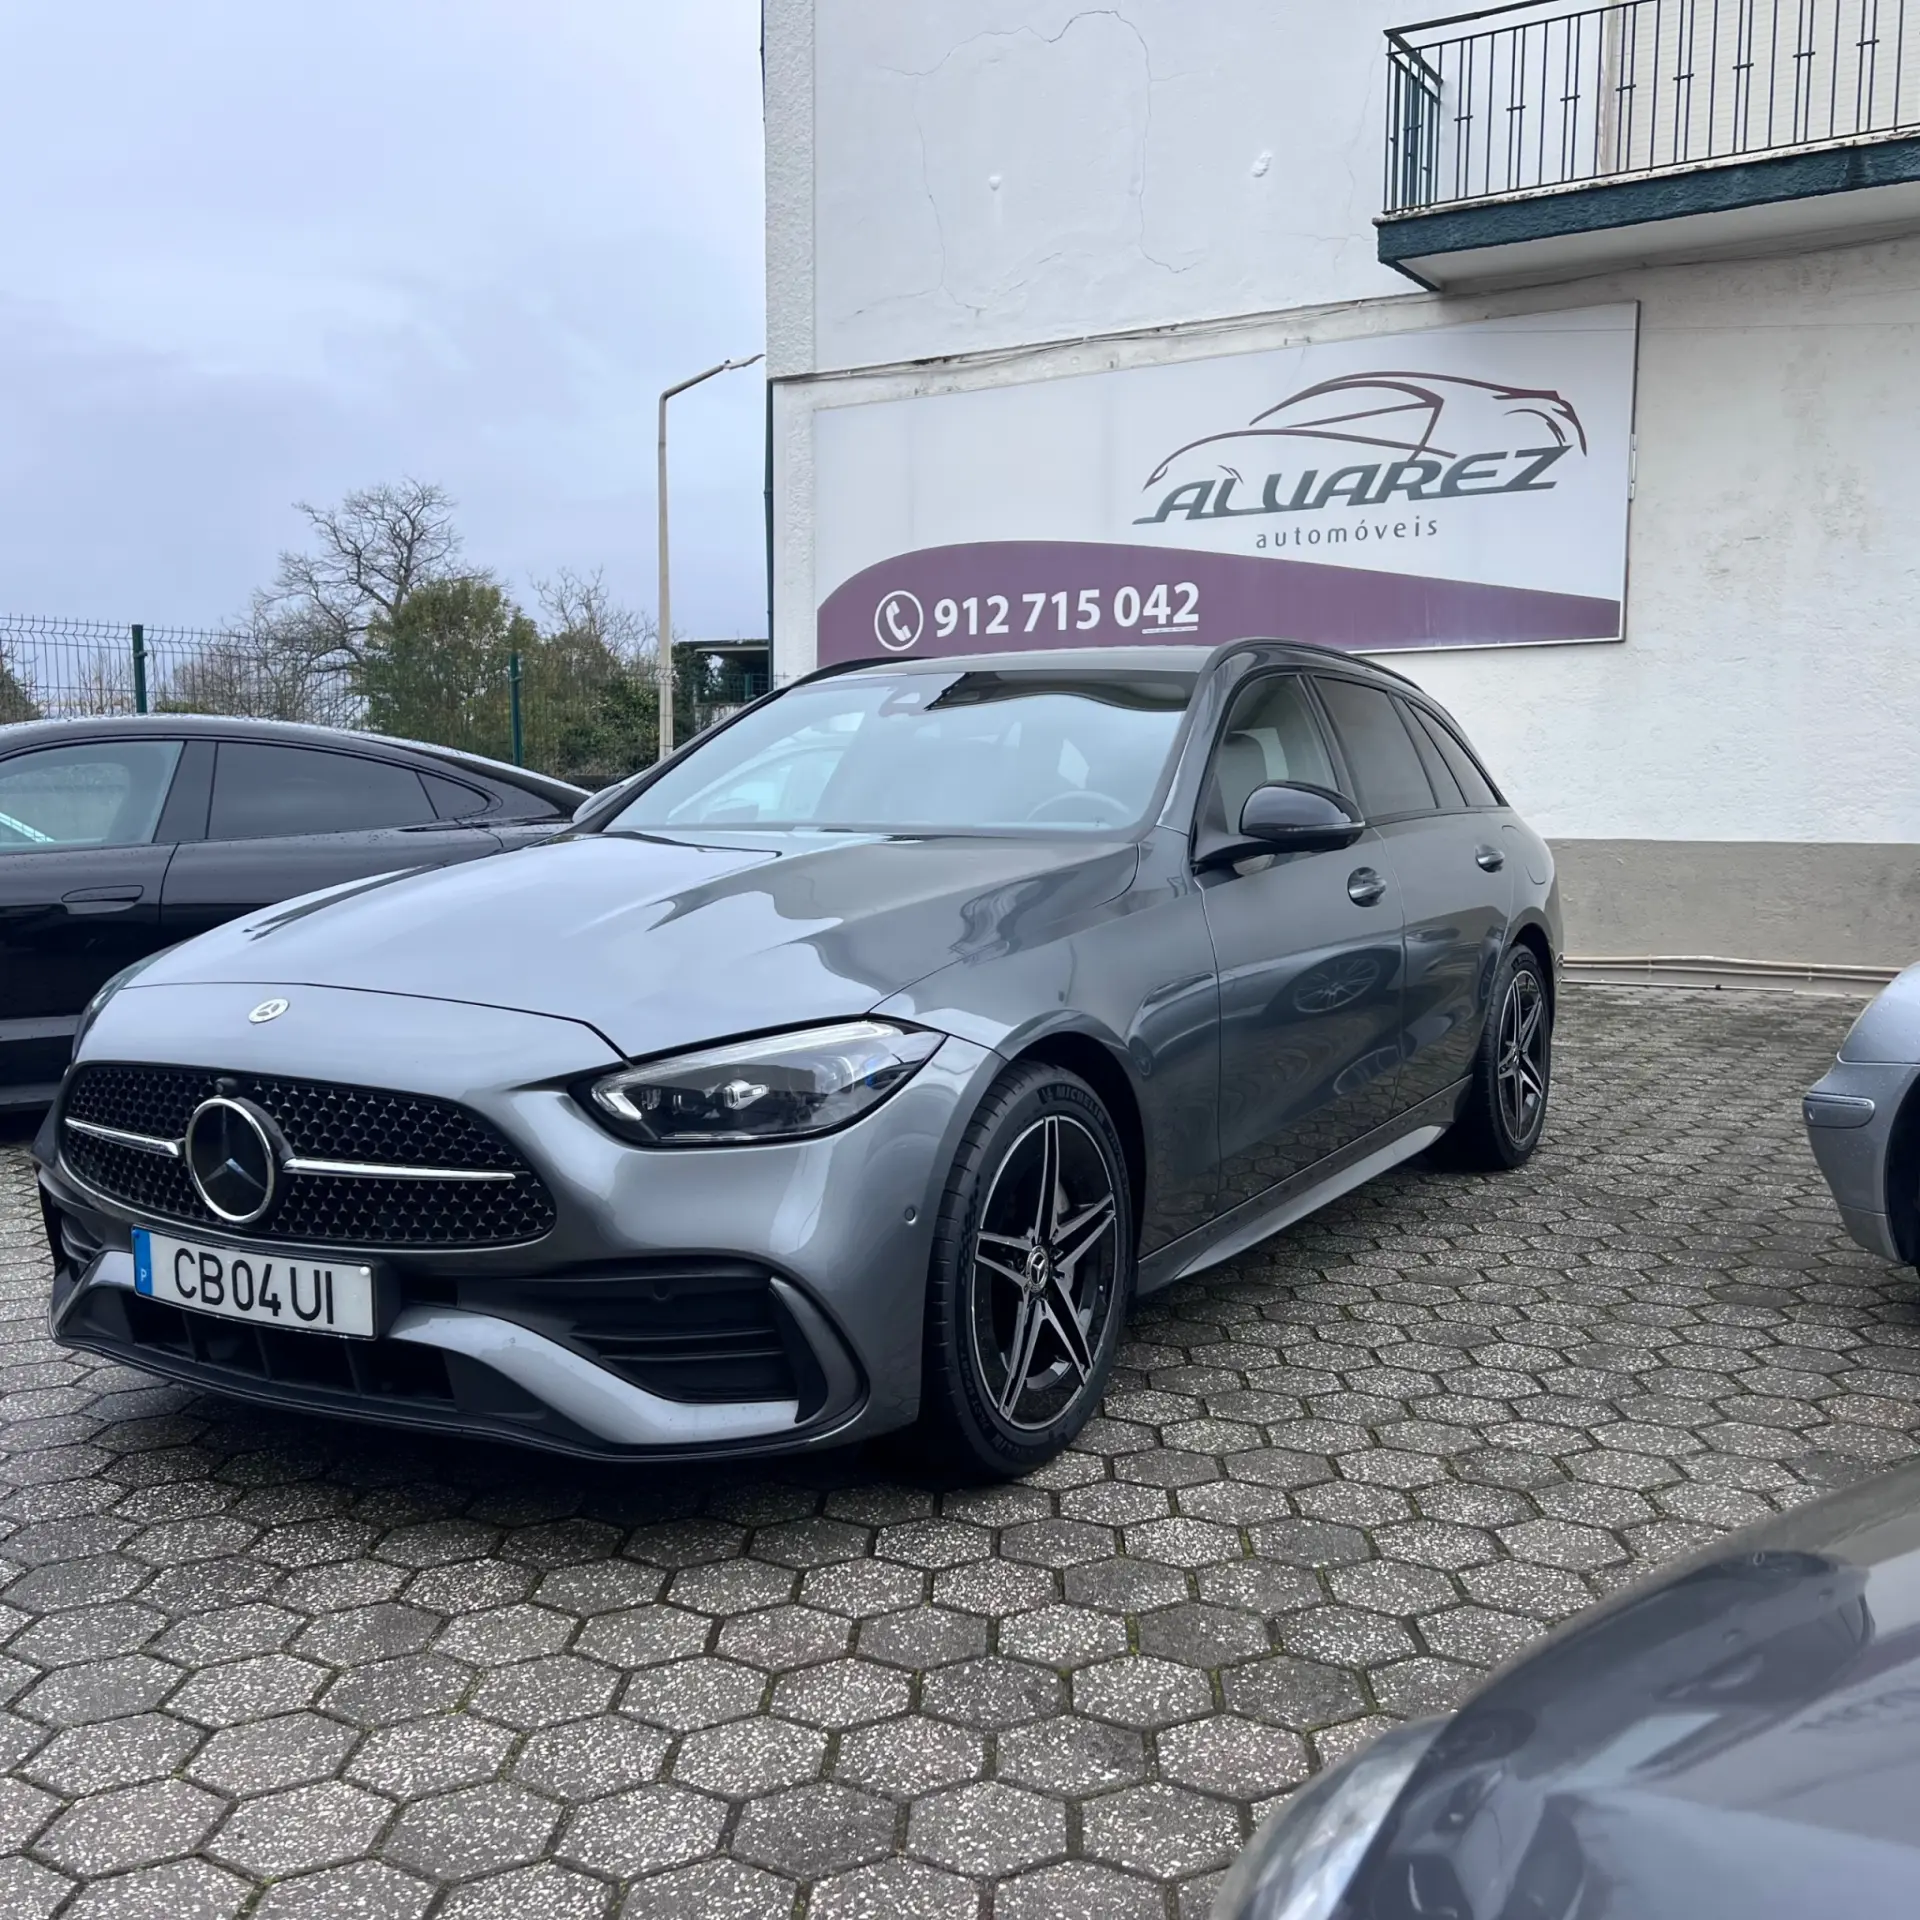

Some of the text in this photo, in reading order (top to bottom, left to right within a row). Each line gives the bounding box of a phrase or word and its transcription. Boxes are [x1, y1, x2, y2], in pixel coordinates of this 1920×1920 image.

[1256, 516, 1438, 549] automóveis
[934, 581, 1199, 638] 912 715 042
[140, 1267, 147, 1282] P
